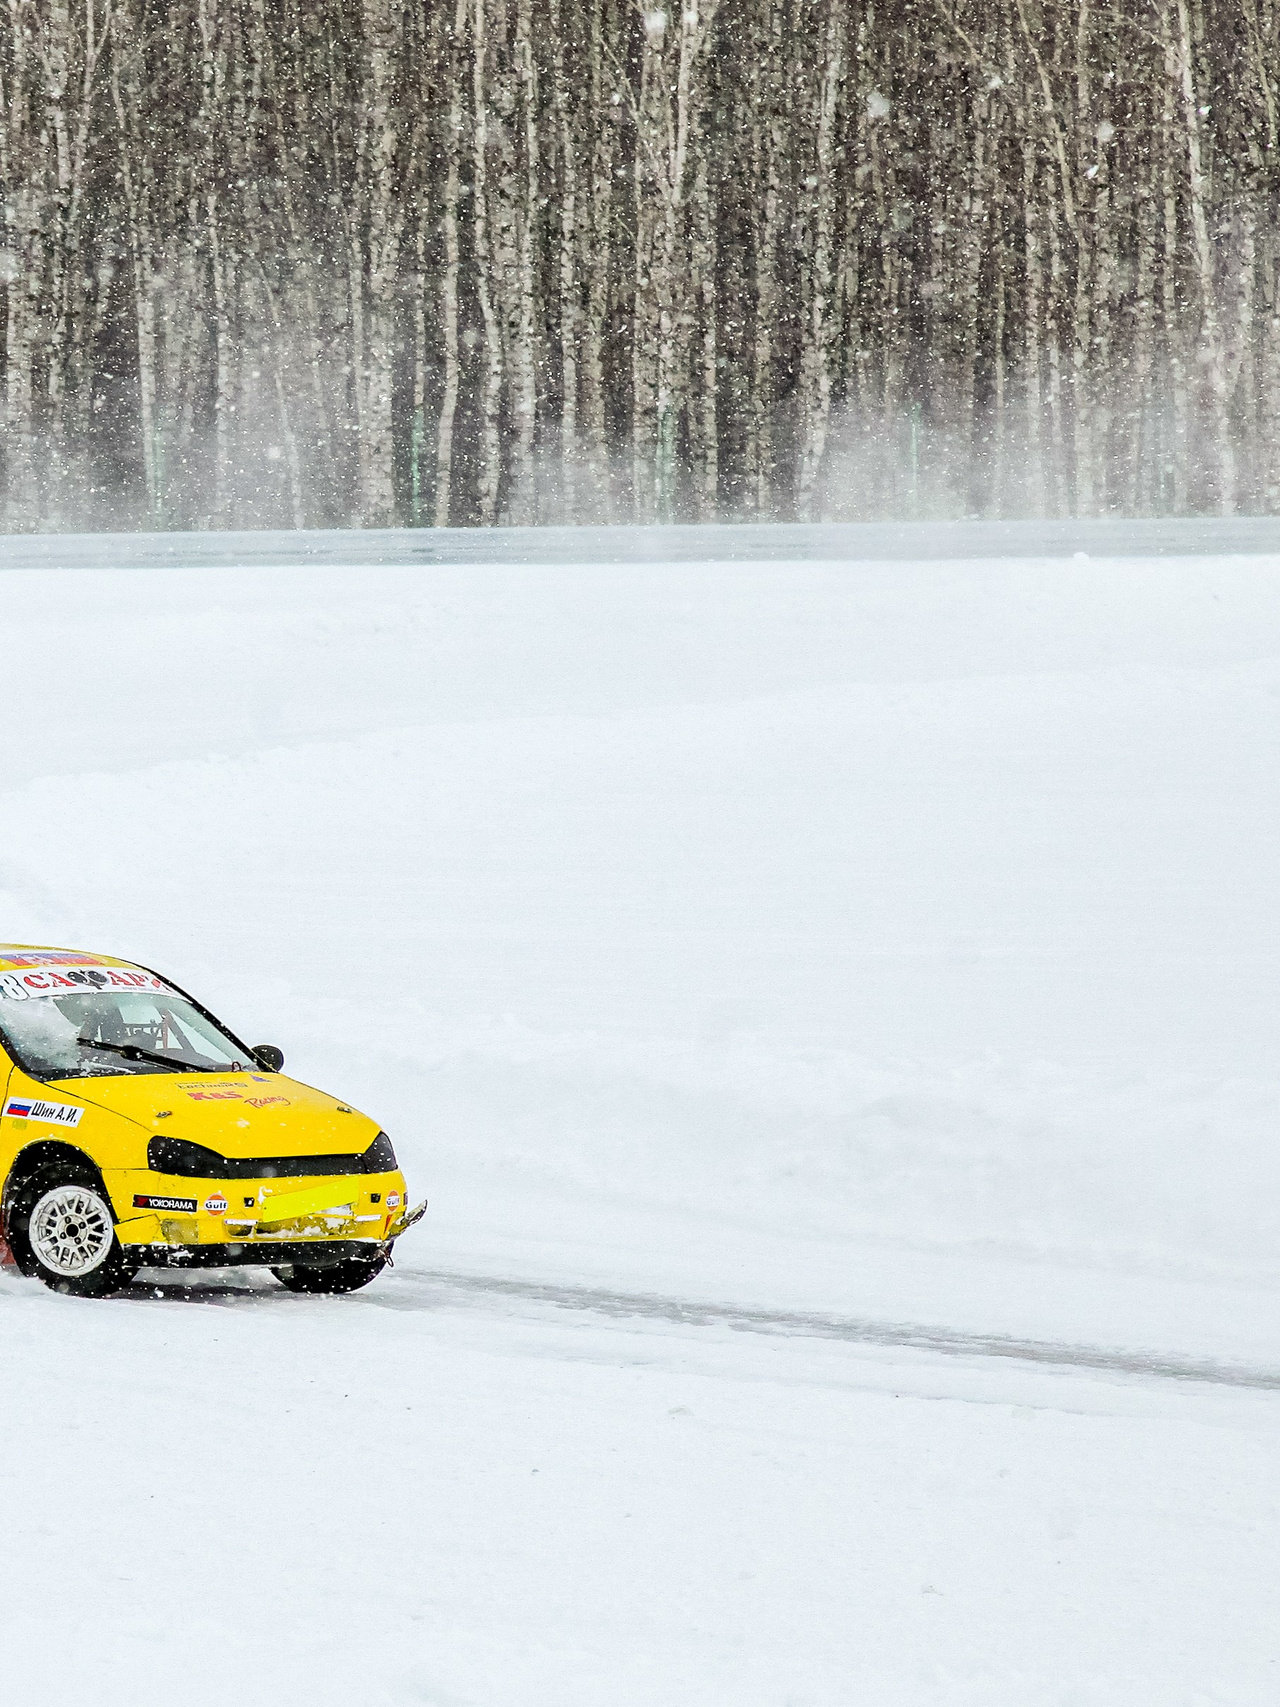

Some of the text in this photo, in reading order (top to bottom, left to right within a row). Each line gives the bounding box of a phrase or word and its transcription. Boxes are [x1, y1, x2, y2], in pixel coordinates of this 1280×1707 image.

[31, 1102, 78, 1123] Шин А.И.
[148, 1198, 194, 1210] YOKOHAMA
[205, 1201, 227, 1209] Gulf
